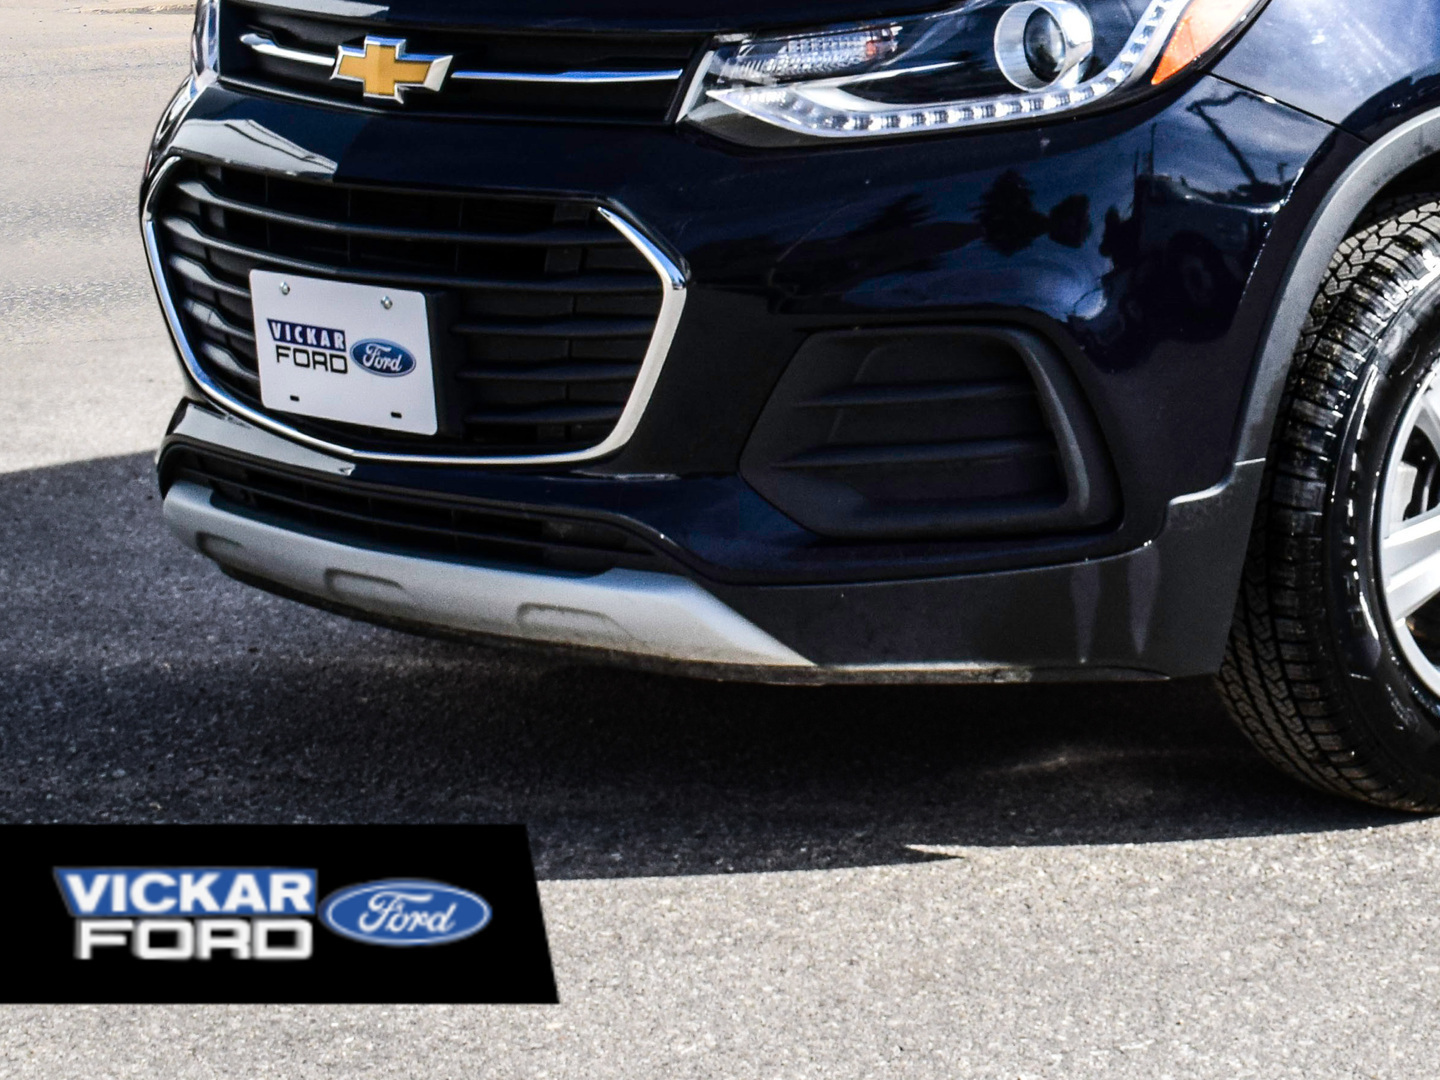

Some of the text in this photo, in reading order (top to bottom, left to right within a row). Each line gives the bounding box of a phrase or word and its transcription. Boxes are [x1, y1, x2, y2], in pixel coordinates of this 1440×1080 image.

[271, 322, 345, 350] VICKAR
[275, 344, 348, 374] FORD
[362, 343, 403, 372] Ford
